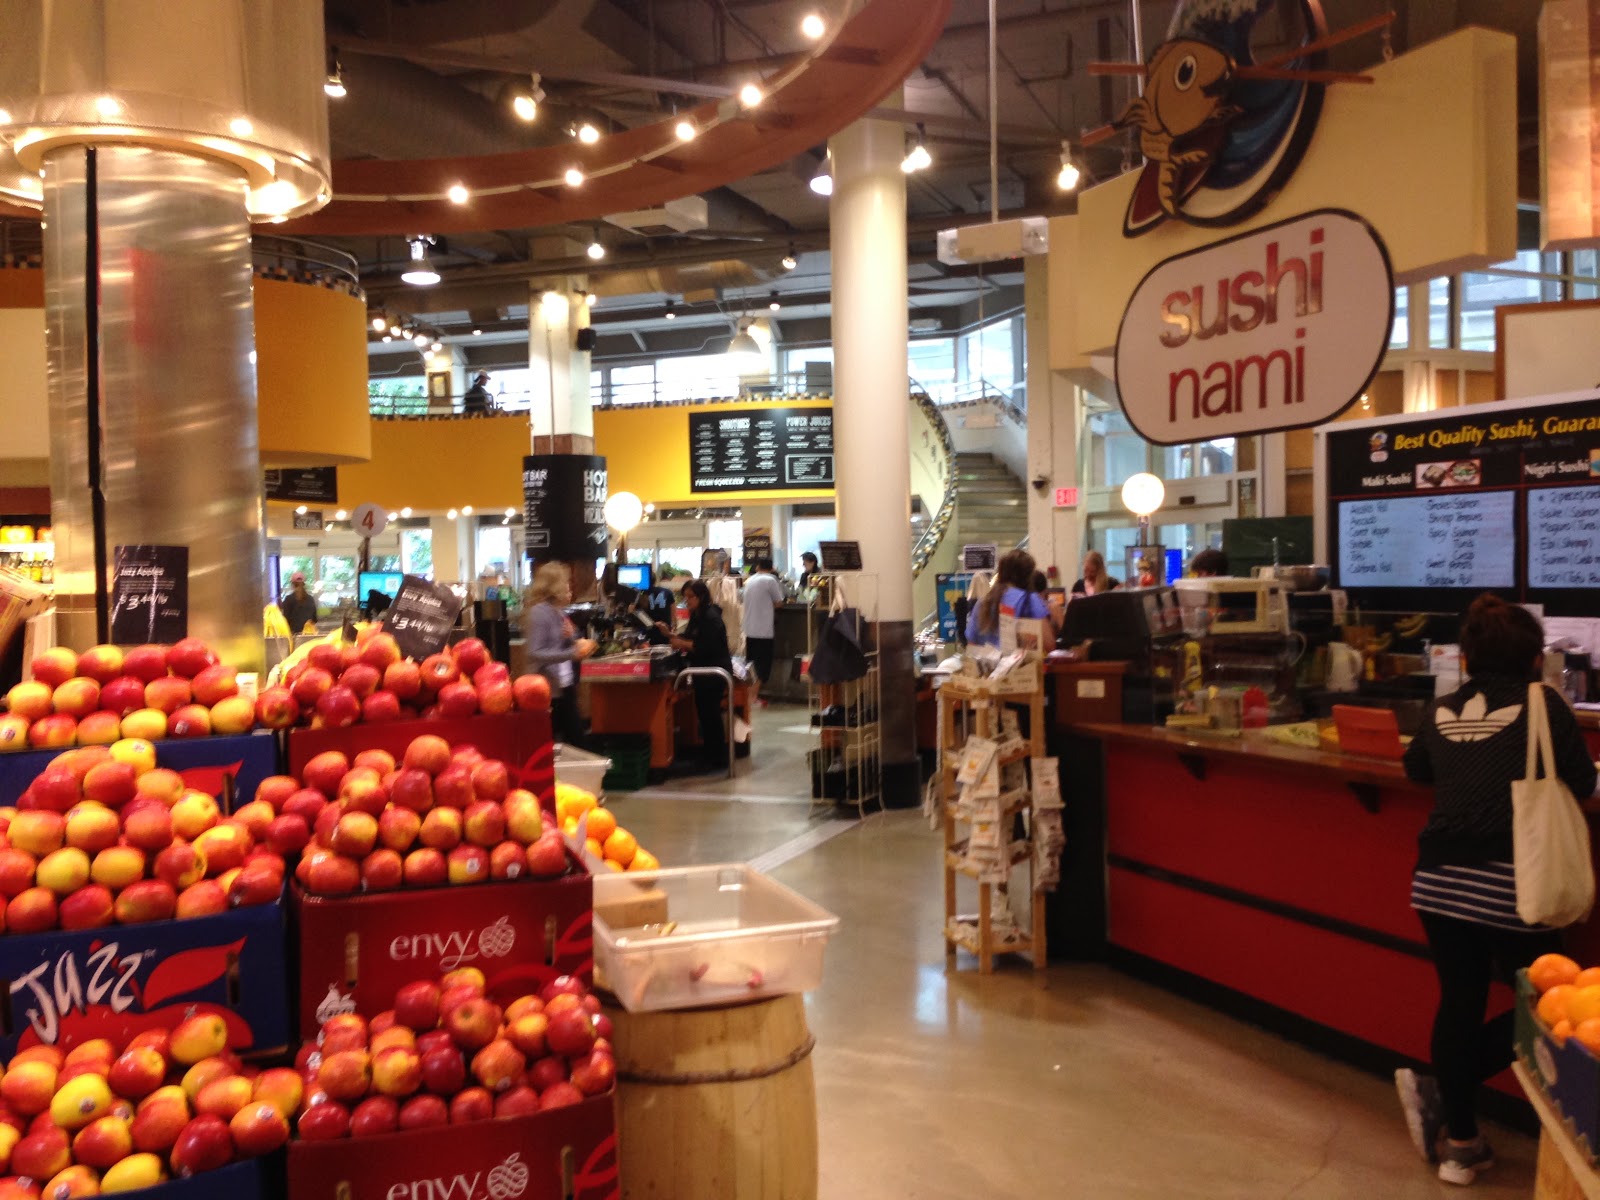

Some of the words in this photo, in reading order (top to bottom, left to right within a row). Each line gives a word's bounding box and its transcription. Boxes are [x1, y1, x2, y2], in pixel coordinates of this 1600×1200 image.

[1159, 227, 1324, 348] sushi
[1168, 327, 1306, 423] nami
[1394, 433, 1426, 450] Best
[1428, 425, 1487, 448] Quality
[1488, 418, 1538, 439] Sushi,
[1542, 414, 1600, 435] Guara
[530, 469, 548, 480] BAR
[1558, 459, 1590, 475] Sushi
[583, 469, 608, 486] HOT
[1386, 472, 1412, 486] Sushi
[584, 487, 608, 502] BAR
[362, 510, 375, 530] 4
[120, 567, 137, 577] Jazz
[137, 566, 164, 577] Apples
[389, 929, 479, 972] envy
